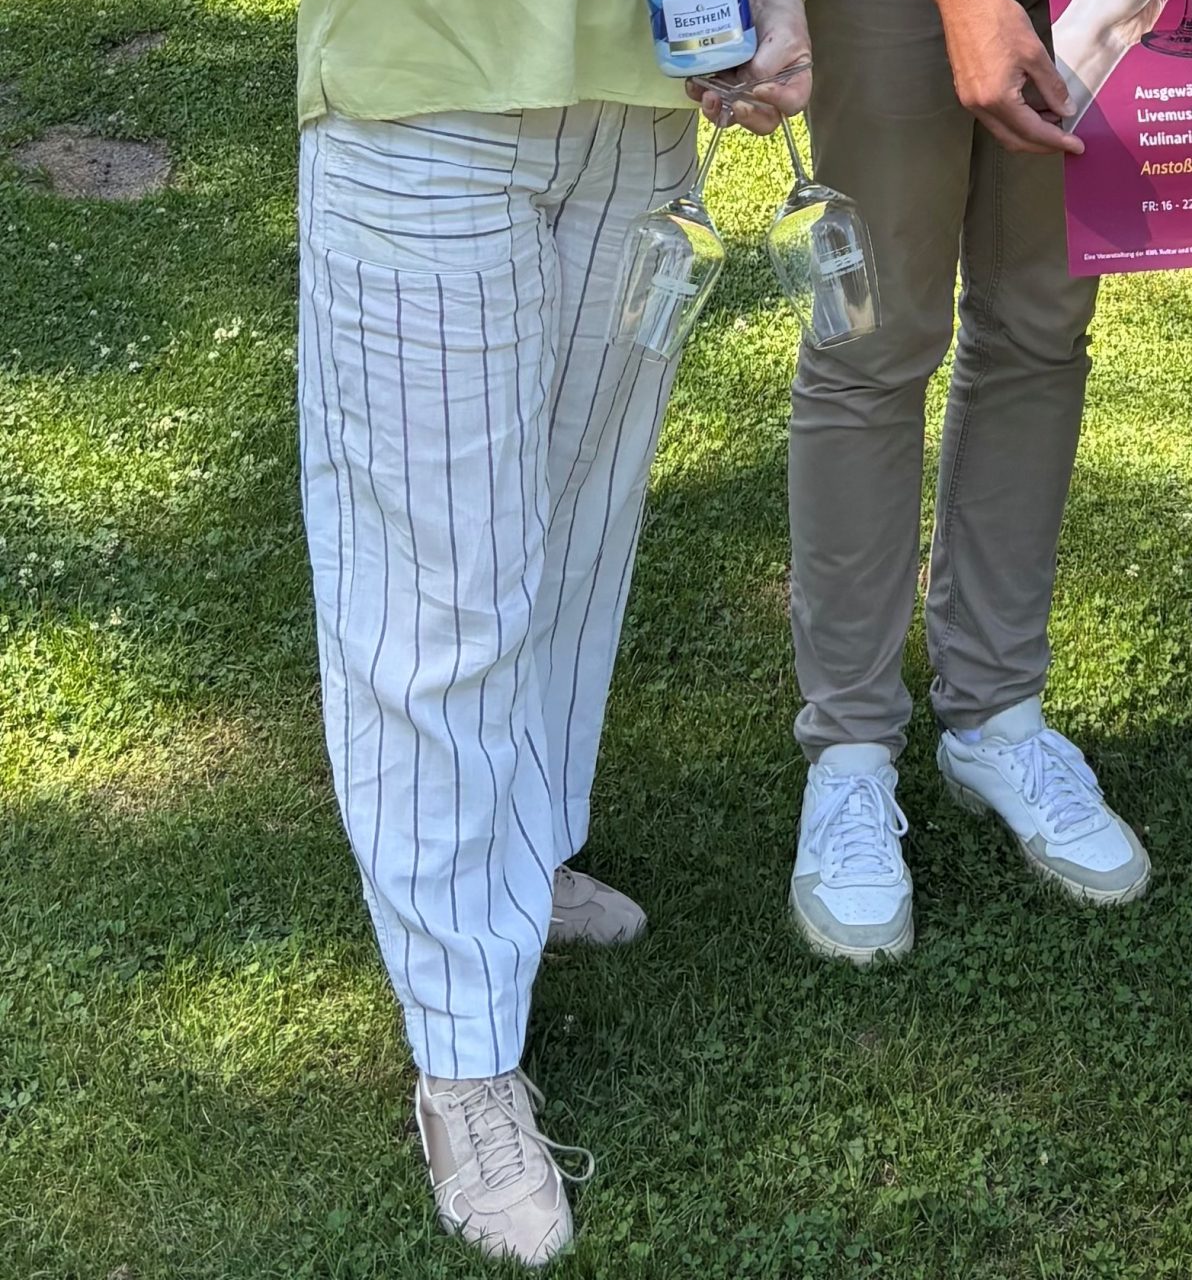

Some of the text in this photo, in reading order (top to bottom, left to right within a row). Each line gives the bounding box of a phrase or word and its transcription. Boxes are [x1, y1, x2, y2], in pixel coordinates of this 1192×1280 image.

[674, 6, 731, 28] BESTHEIM
[1142, 200, 1159, 212] FR:
[1161, 200, 1173, 211] 16
